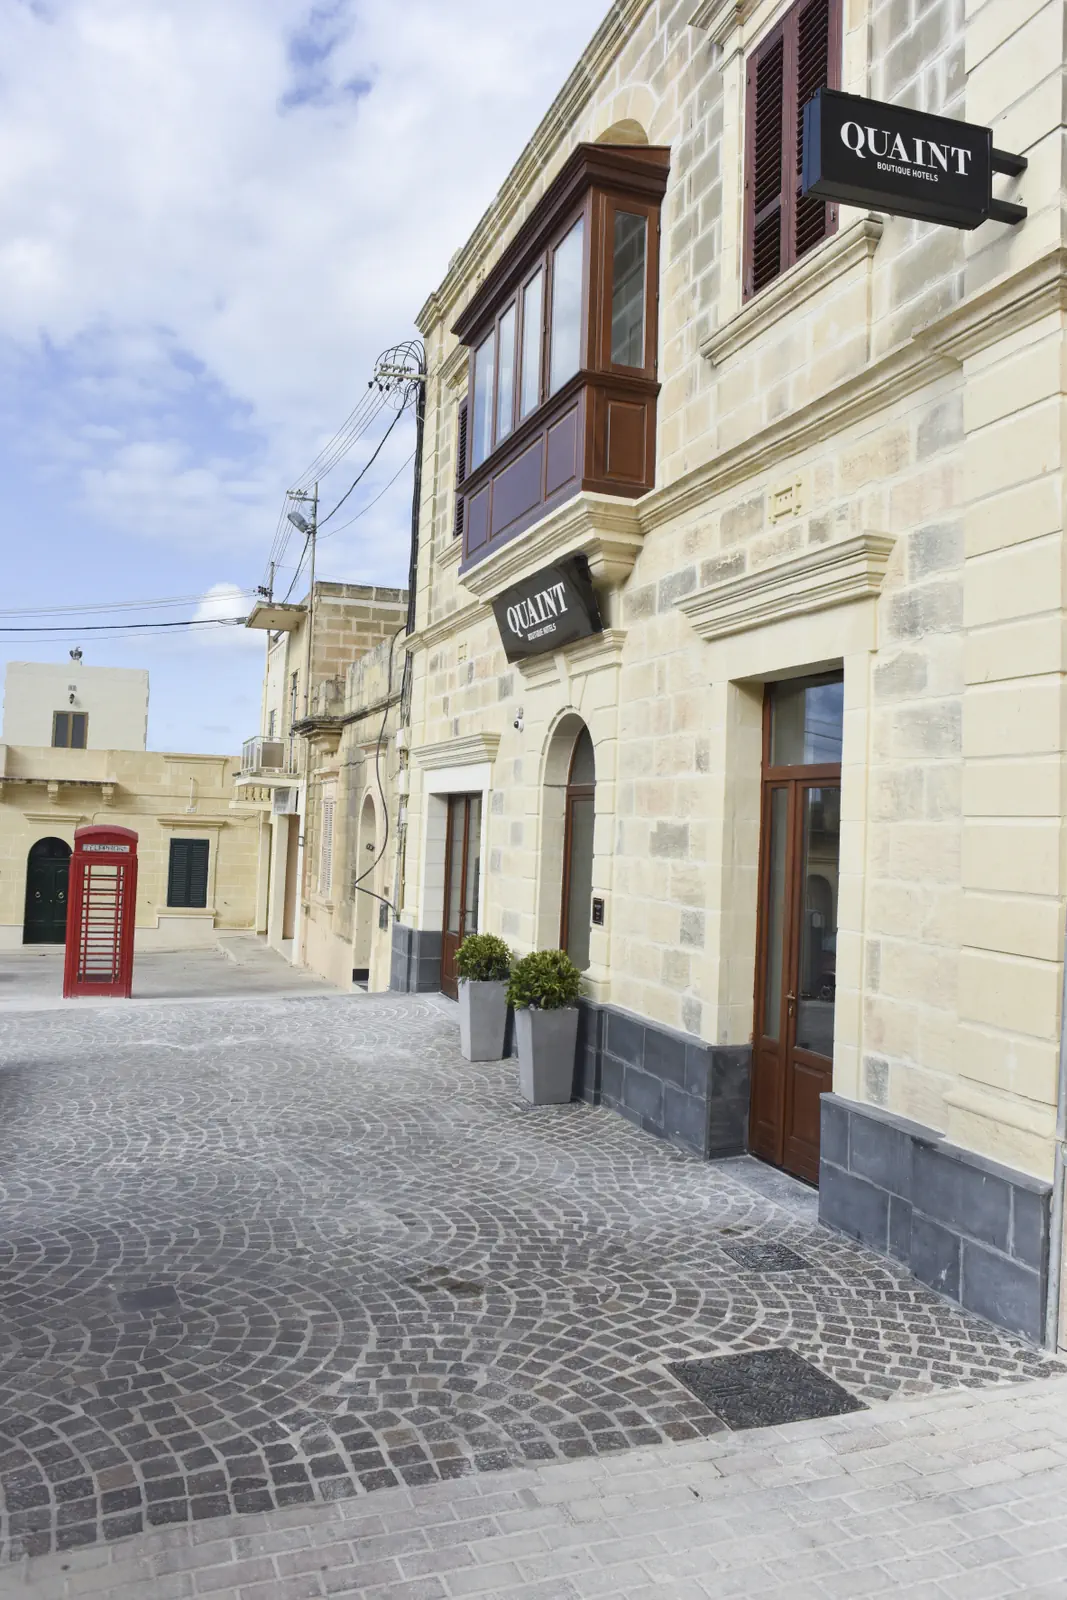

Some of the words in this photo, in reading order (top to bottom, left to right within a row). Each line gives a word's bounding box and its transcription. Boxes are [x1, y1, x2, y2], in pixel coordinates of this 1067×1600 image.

[840, 121, 972, 176] QUAINT
[877, 161, 911, 177] BOUTIQUE
[912, 169, 939, 182] HOTELS
[506, 581, 568, 638] QUAINT
